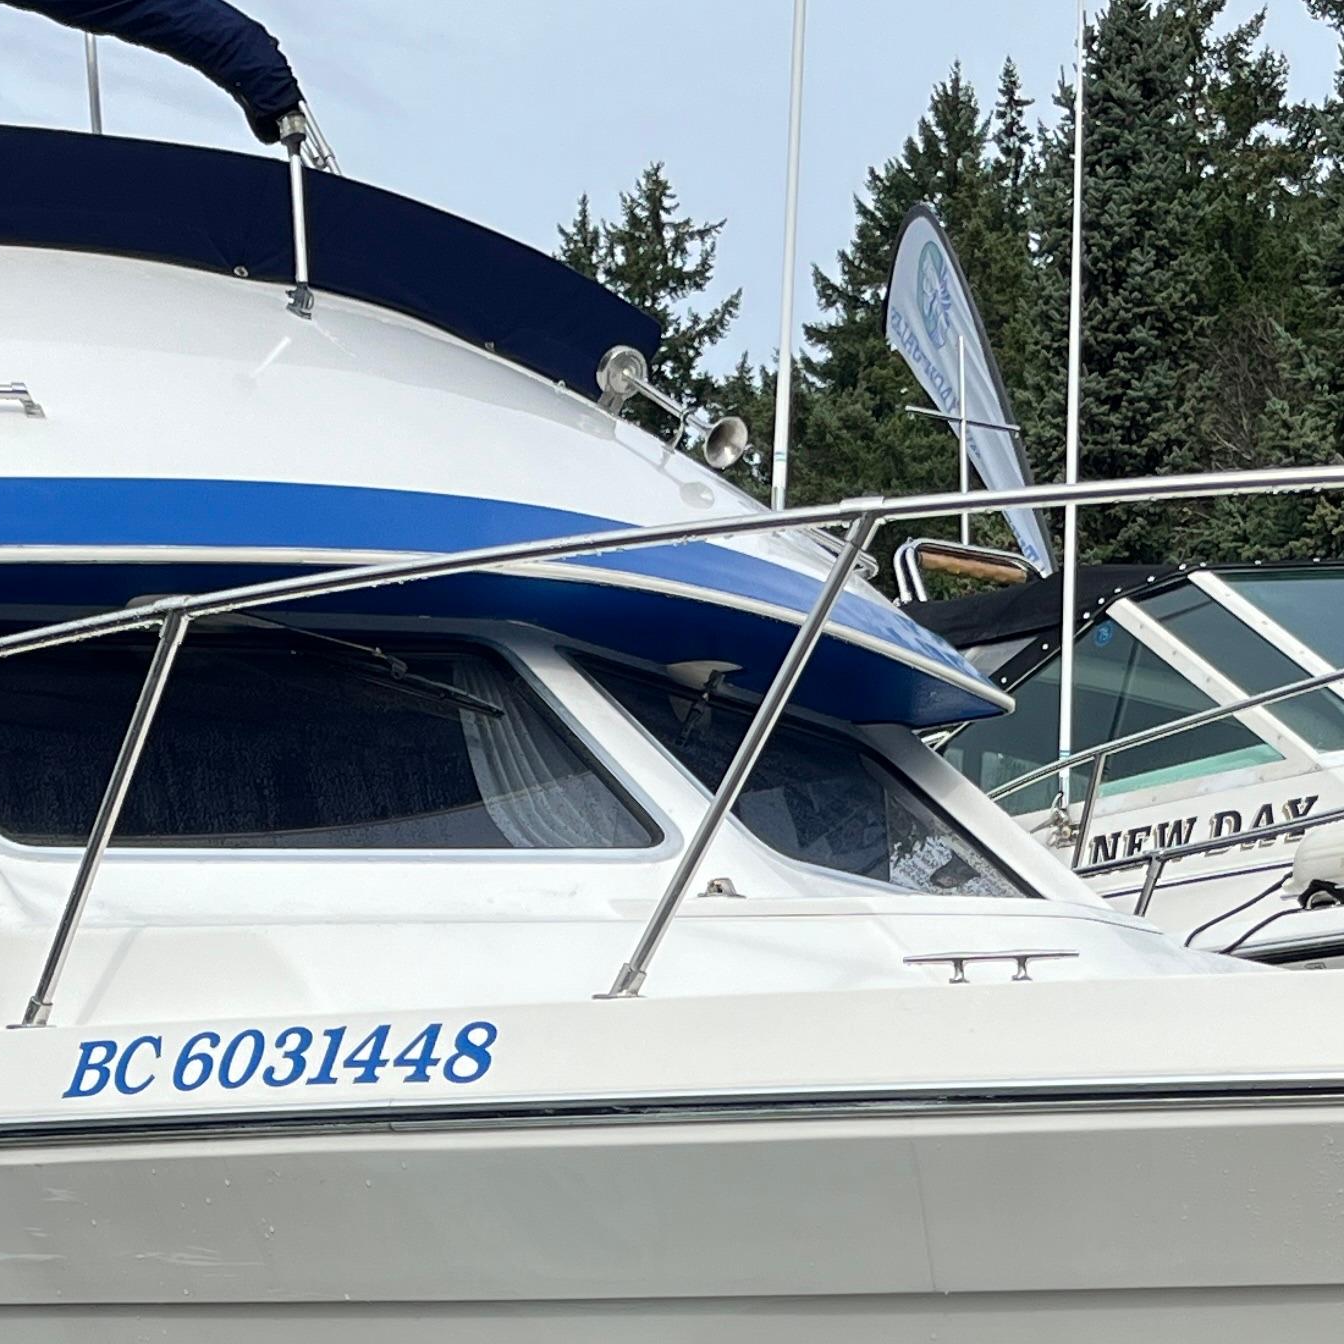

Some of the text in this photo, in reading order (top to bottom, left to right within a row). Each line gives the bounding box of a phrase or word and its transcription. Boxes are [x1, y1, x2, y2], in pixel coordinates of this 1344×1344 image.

[1089, 795, 1318, 868] NEW DAY
[62, 1021, 497, 1099] BC 6031448
